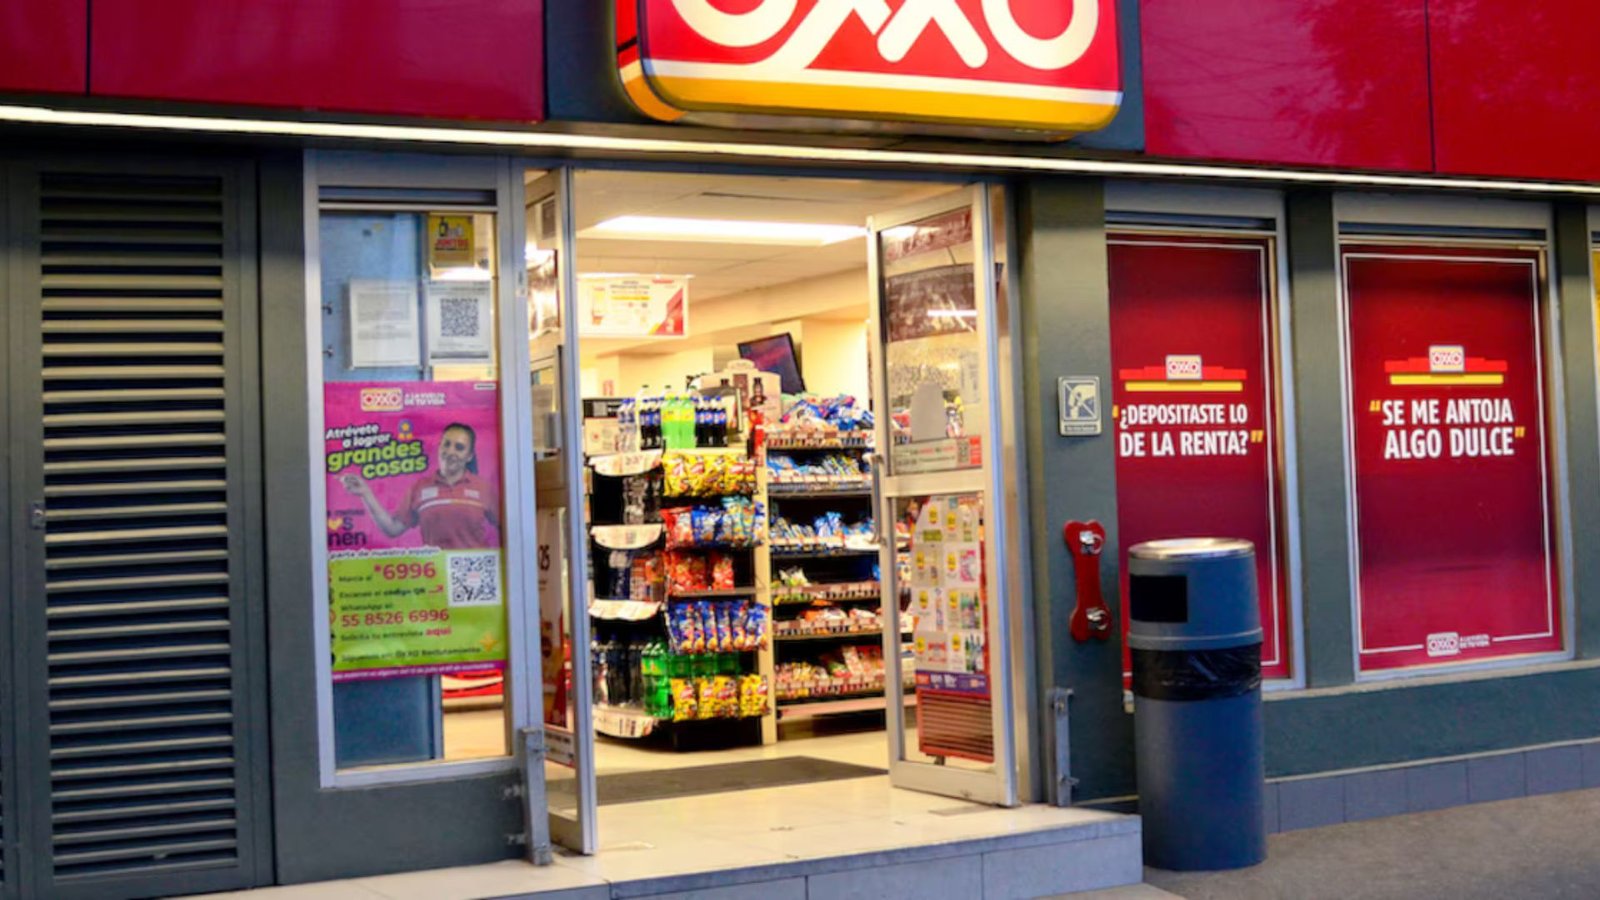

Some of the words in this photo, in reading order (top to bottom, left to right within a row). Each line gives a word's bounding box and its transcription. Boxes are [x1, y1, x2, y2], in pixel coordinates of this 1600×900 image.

[362, 391, 402, 408] OXXO
[1229, 404, 1247, 423] LO
[1411, 399, 1440, 425] ME
[1445, 398, 1514, 424] ANTOJA
[342, 438, 351, 448] a
[353, 433, 391, 448] lograr
[1120, 432, 1145, 457] DE
[1151, 431, 1175, 457] LA
[1384, 429, 1442, 460] ALGO
[327, 440, 421, 472] grandes
[362, 456, 427, 479] cosas
[342, 613, 360, 627] 55
[365, 611, 404, 626] 8526
[409, 609, 450, 622] 6996
[426, 627, 452, 637] aquí
